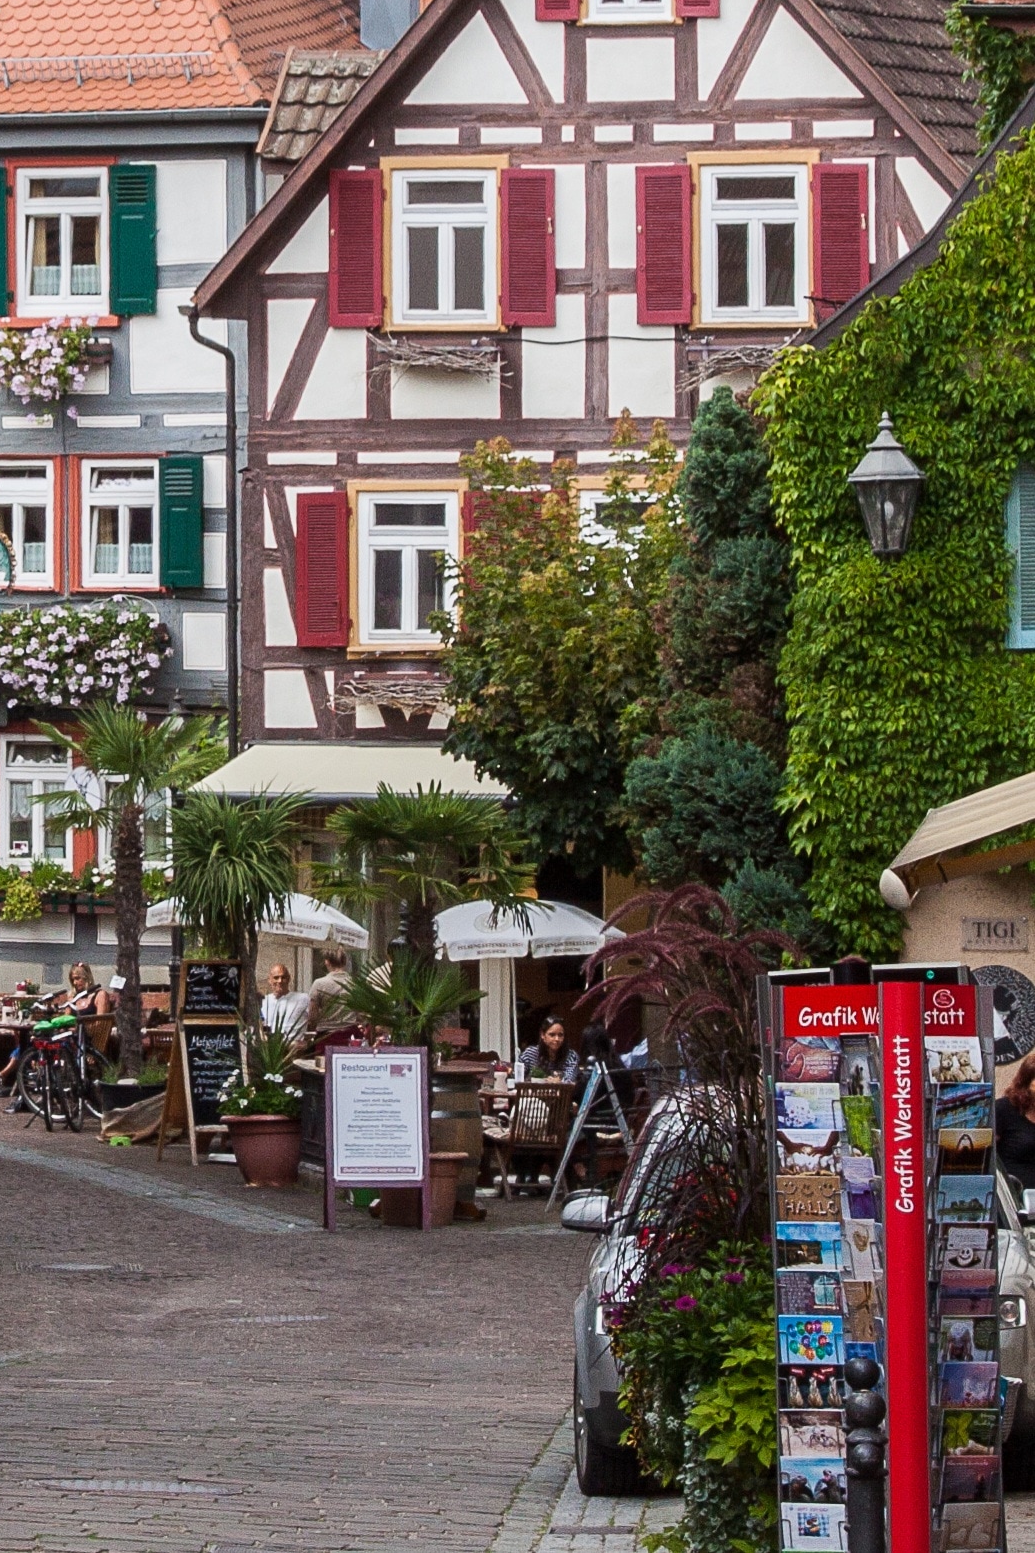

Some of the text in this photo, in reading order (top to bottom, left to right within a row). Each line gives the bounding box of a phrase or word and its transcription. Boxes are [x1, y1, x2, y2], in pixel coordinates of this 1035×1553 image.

[798, 1006, 857, 1027] Grafik
[341, 1064, 388, 1072] Restaurant
[892, 1035, 915, 1213] Grafik Werkstatt
[784, 1199, 839, 1216] HALLO
